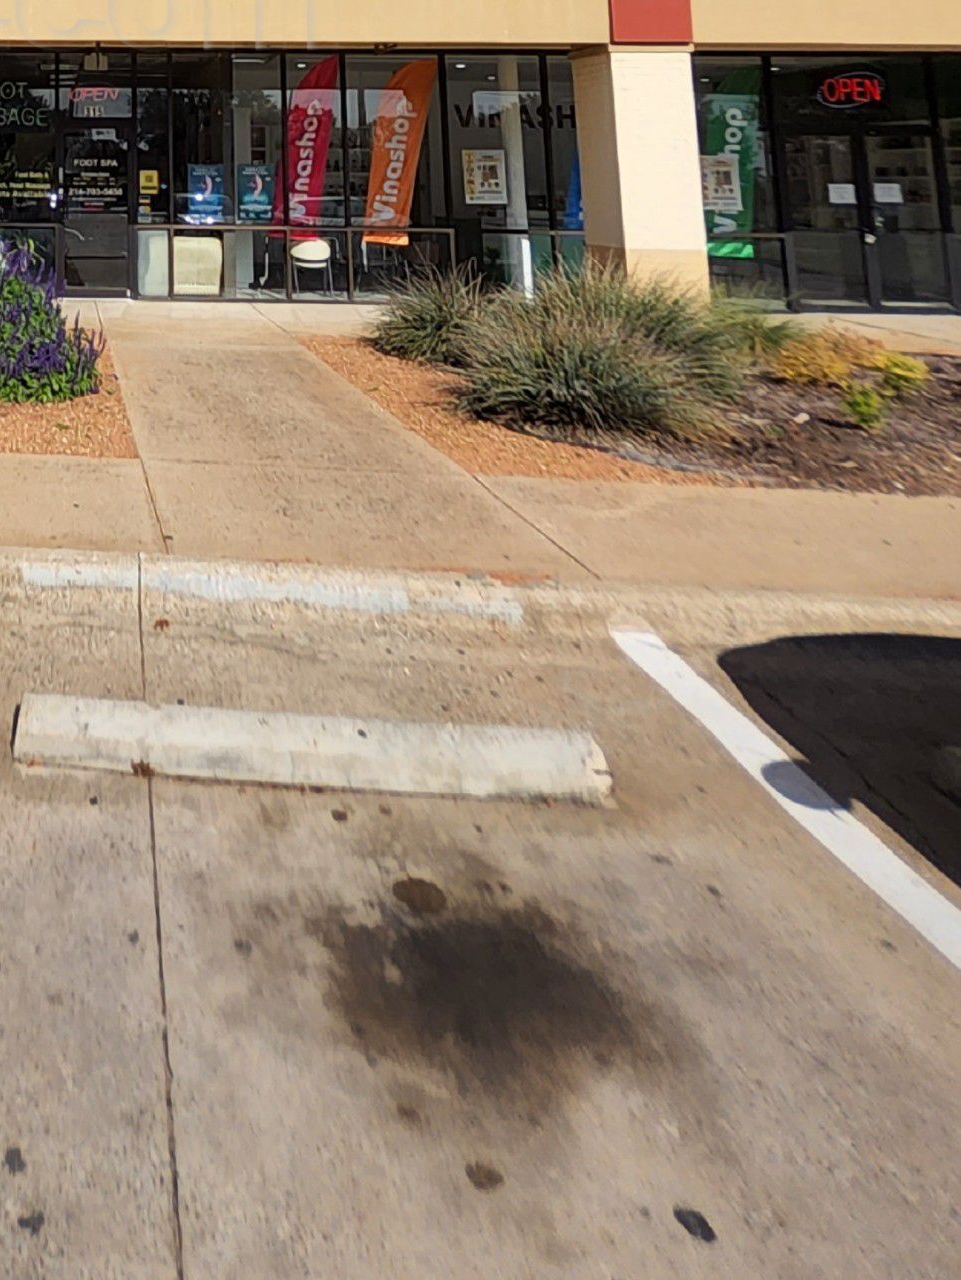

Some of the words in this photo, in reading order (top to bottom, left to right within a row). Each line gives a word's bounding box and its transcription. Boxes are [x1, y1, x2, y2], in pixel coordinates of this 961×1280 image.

[68, 86, 119, 102] OPEN
[823, 77, 882, 102] OPEN
[73, 158, 98, 167] FOOT
[100, 158, 118, 167] SPA
[289, 98, 323, 222] Vinashop
[371, 94, 418, 221] Vinashop
